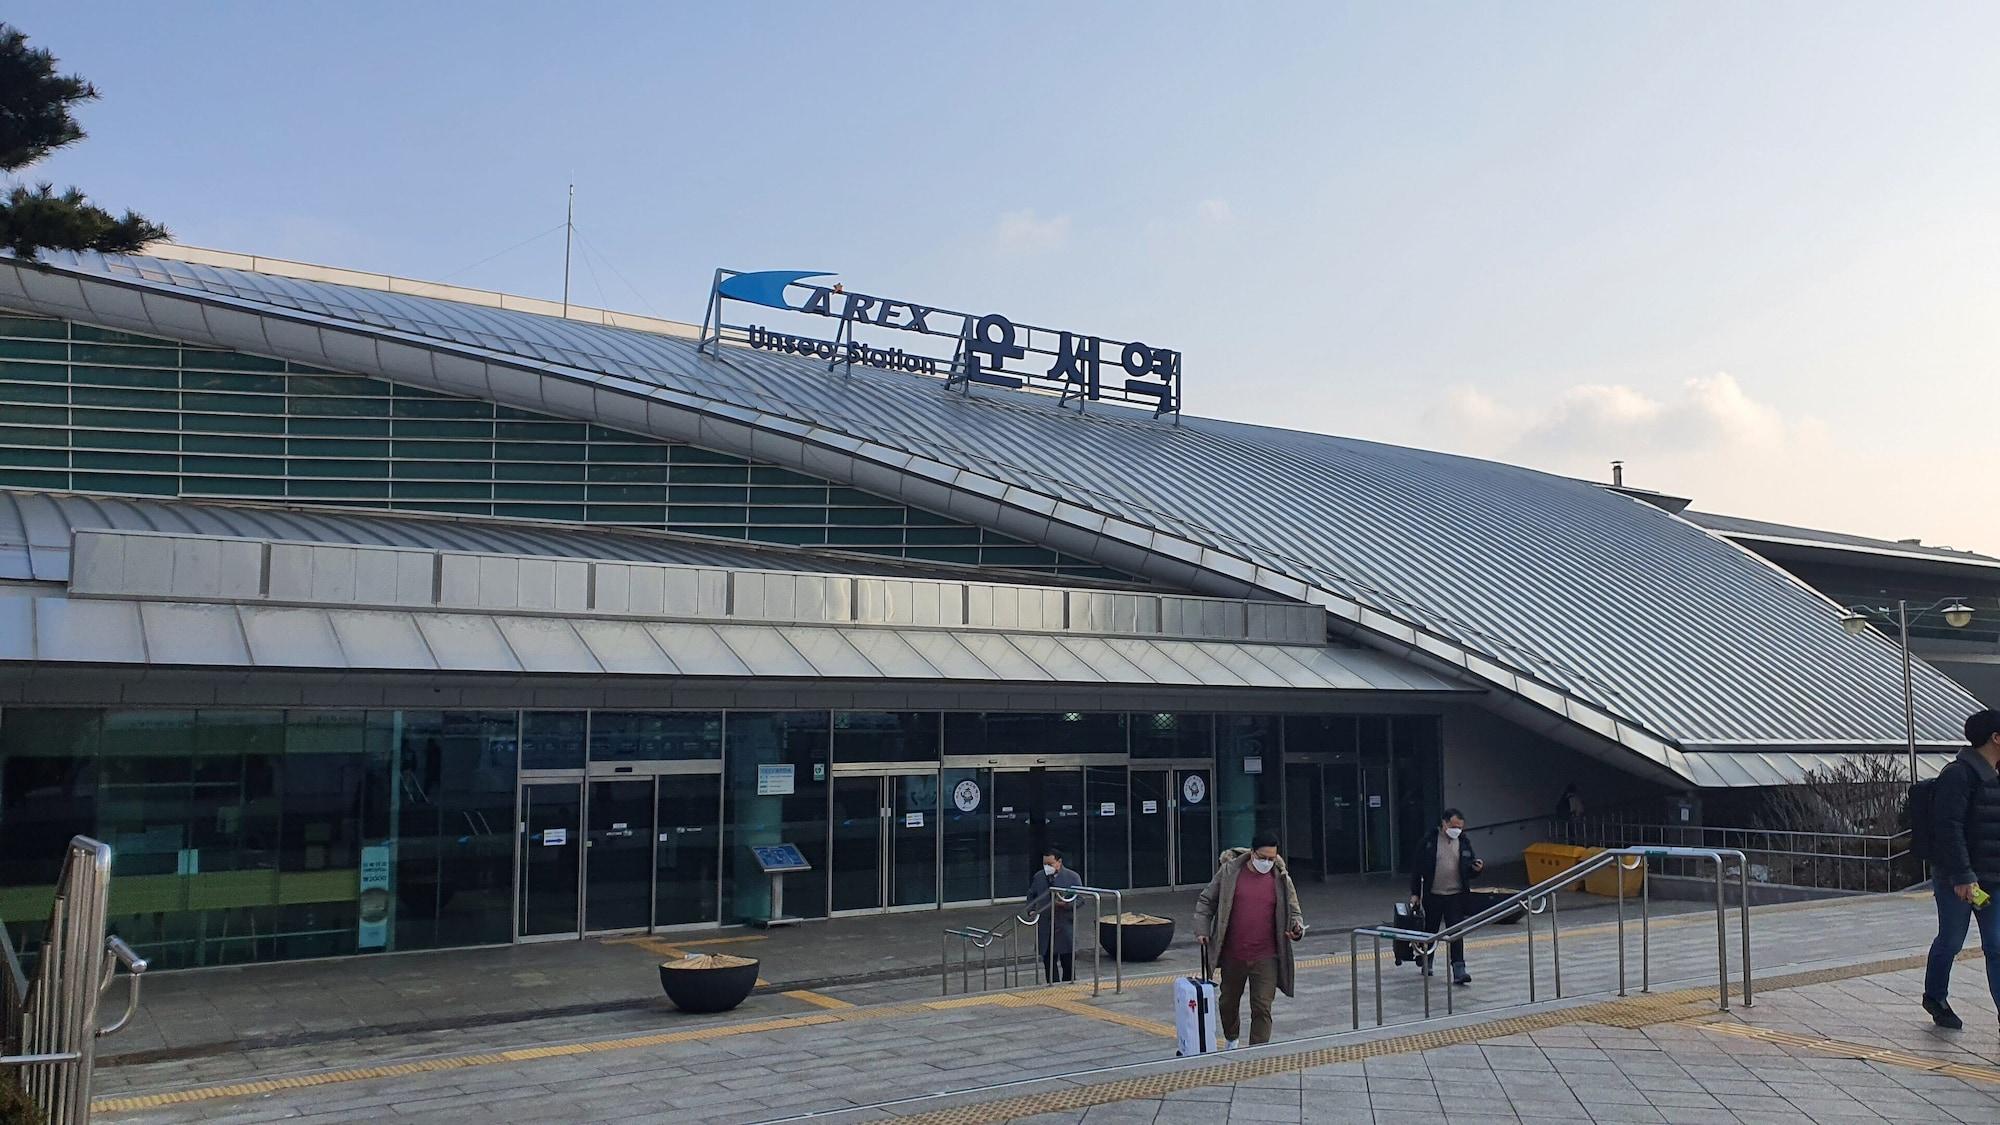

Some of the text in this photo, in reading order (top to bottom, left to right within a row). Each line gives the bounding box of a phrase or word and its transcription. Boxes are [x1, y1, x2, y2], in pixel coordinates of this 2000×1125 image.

[802, 287, 933, 333] AREX
[750, 324, 936, 375] Unseo Station
[967, 313, 1171, 413] 운서역
